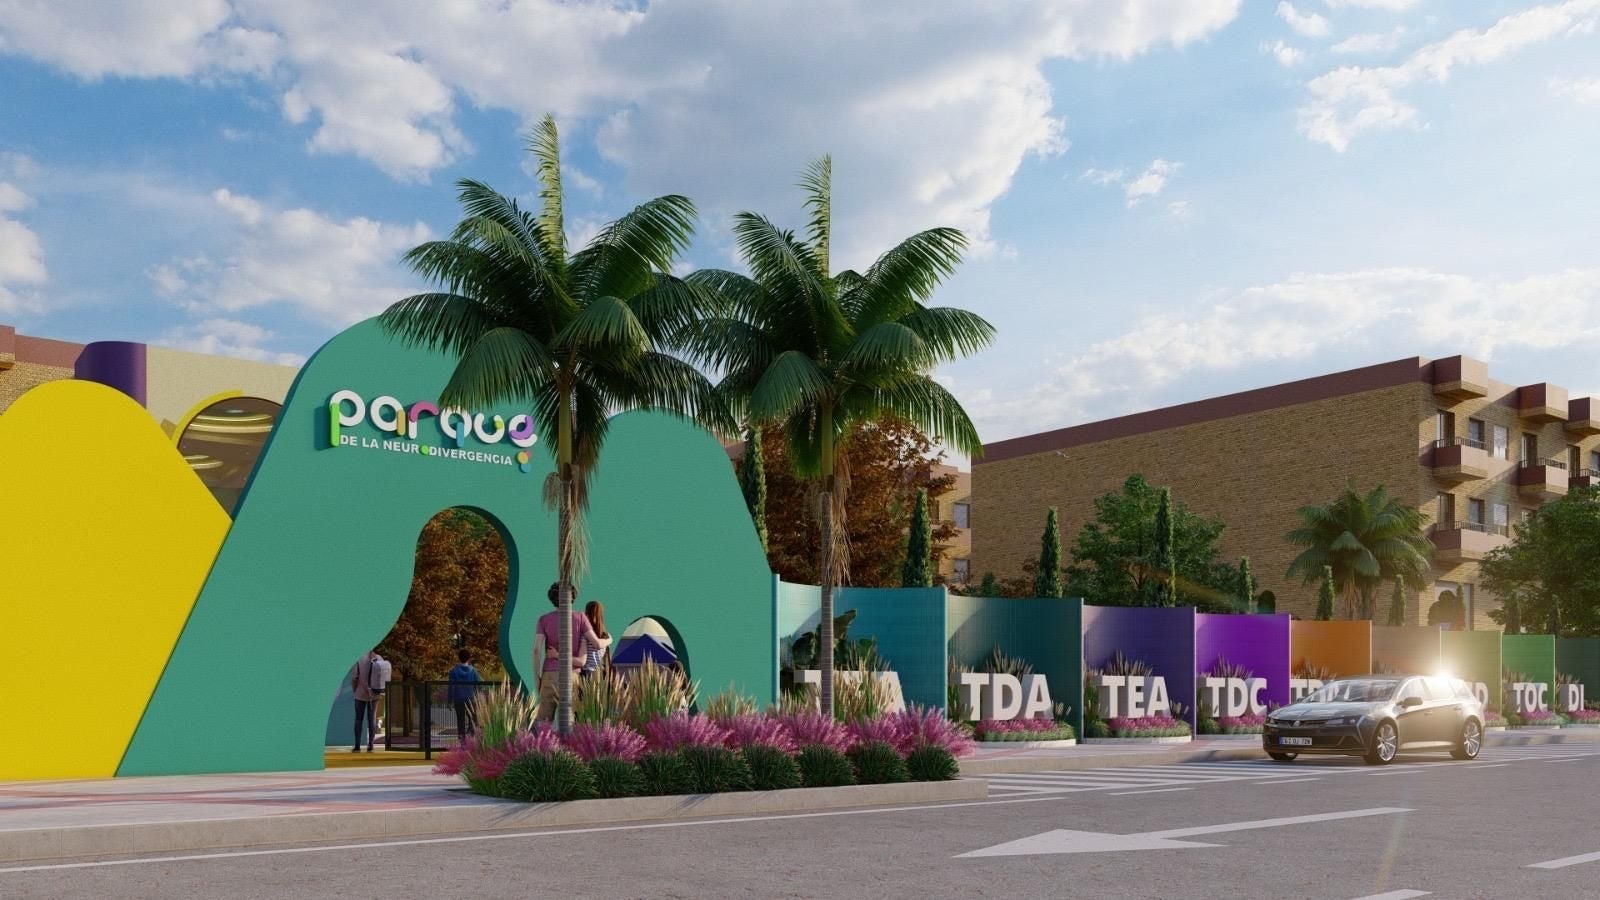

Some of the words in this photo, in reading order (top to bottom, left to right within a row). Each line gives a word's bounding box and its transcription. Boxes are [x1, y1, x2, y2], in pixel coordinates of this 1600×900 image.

[330, 389, 538, 448] parque
[340, 434, 358, 446] DE
[362, 437, 379, 449] LA
[961, 672, 1053, 721] TDA
[1102, 675, 1171, 719] TEA
[1206, 677, 1268, 718] TDC
[1513, 682, 1549, 713] TOC
[1568, 683, 1585, 712] DI
